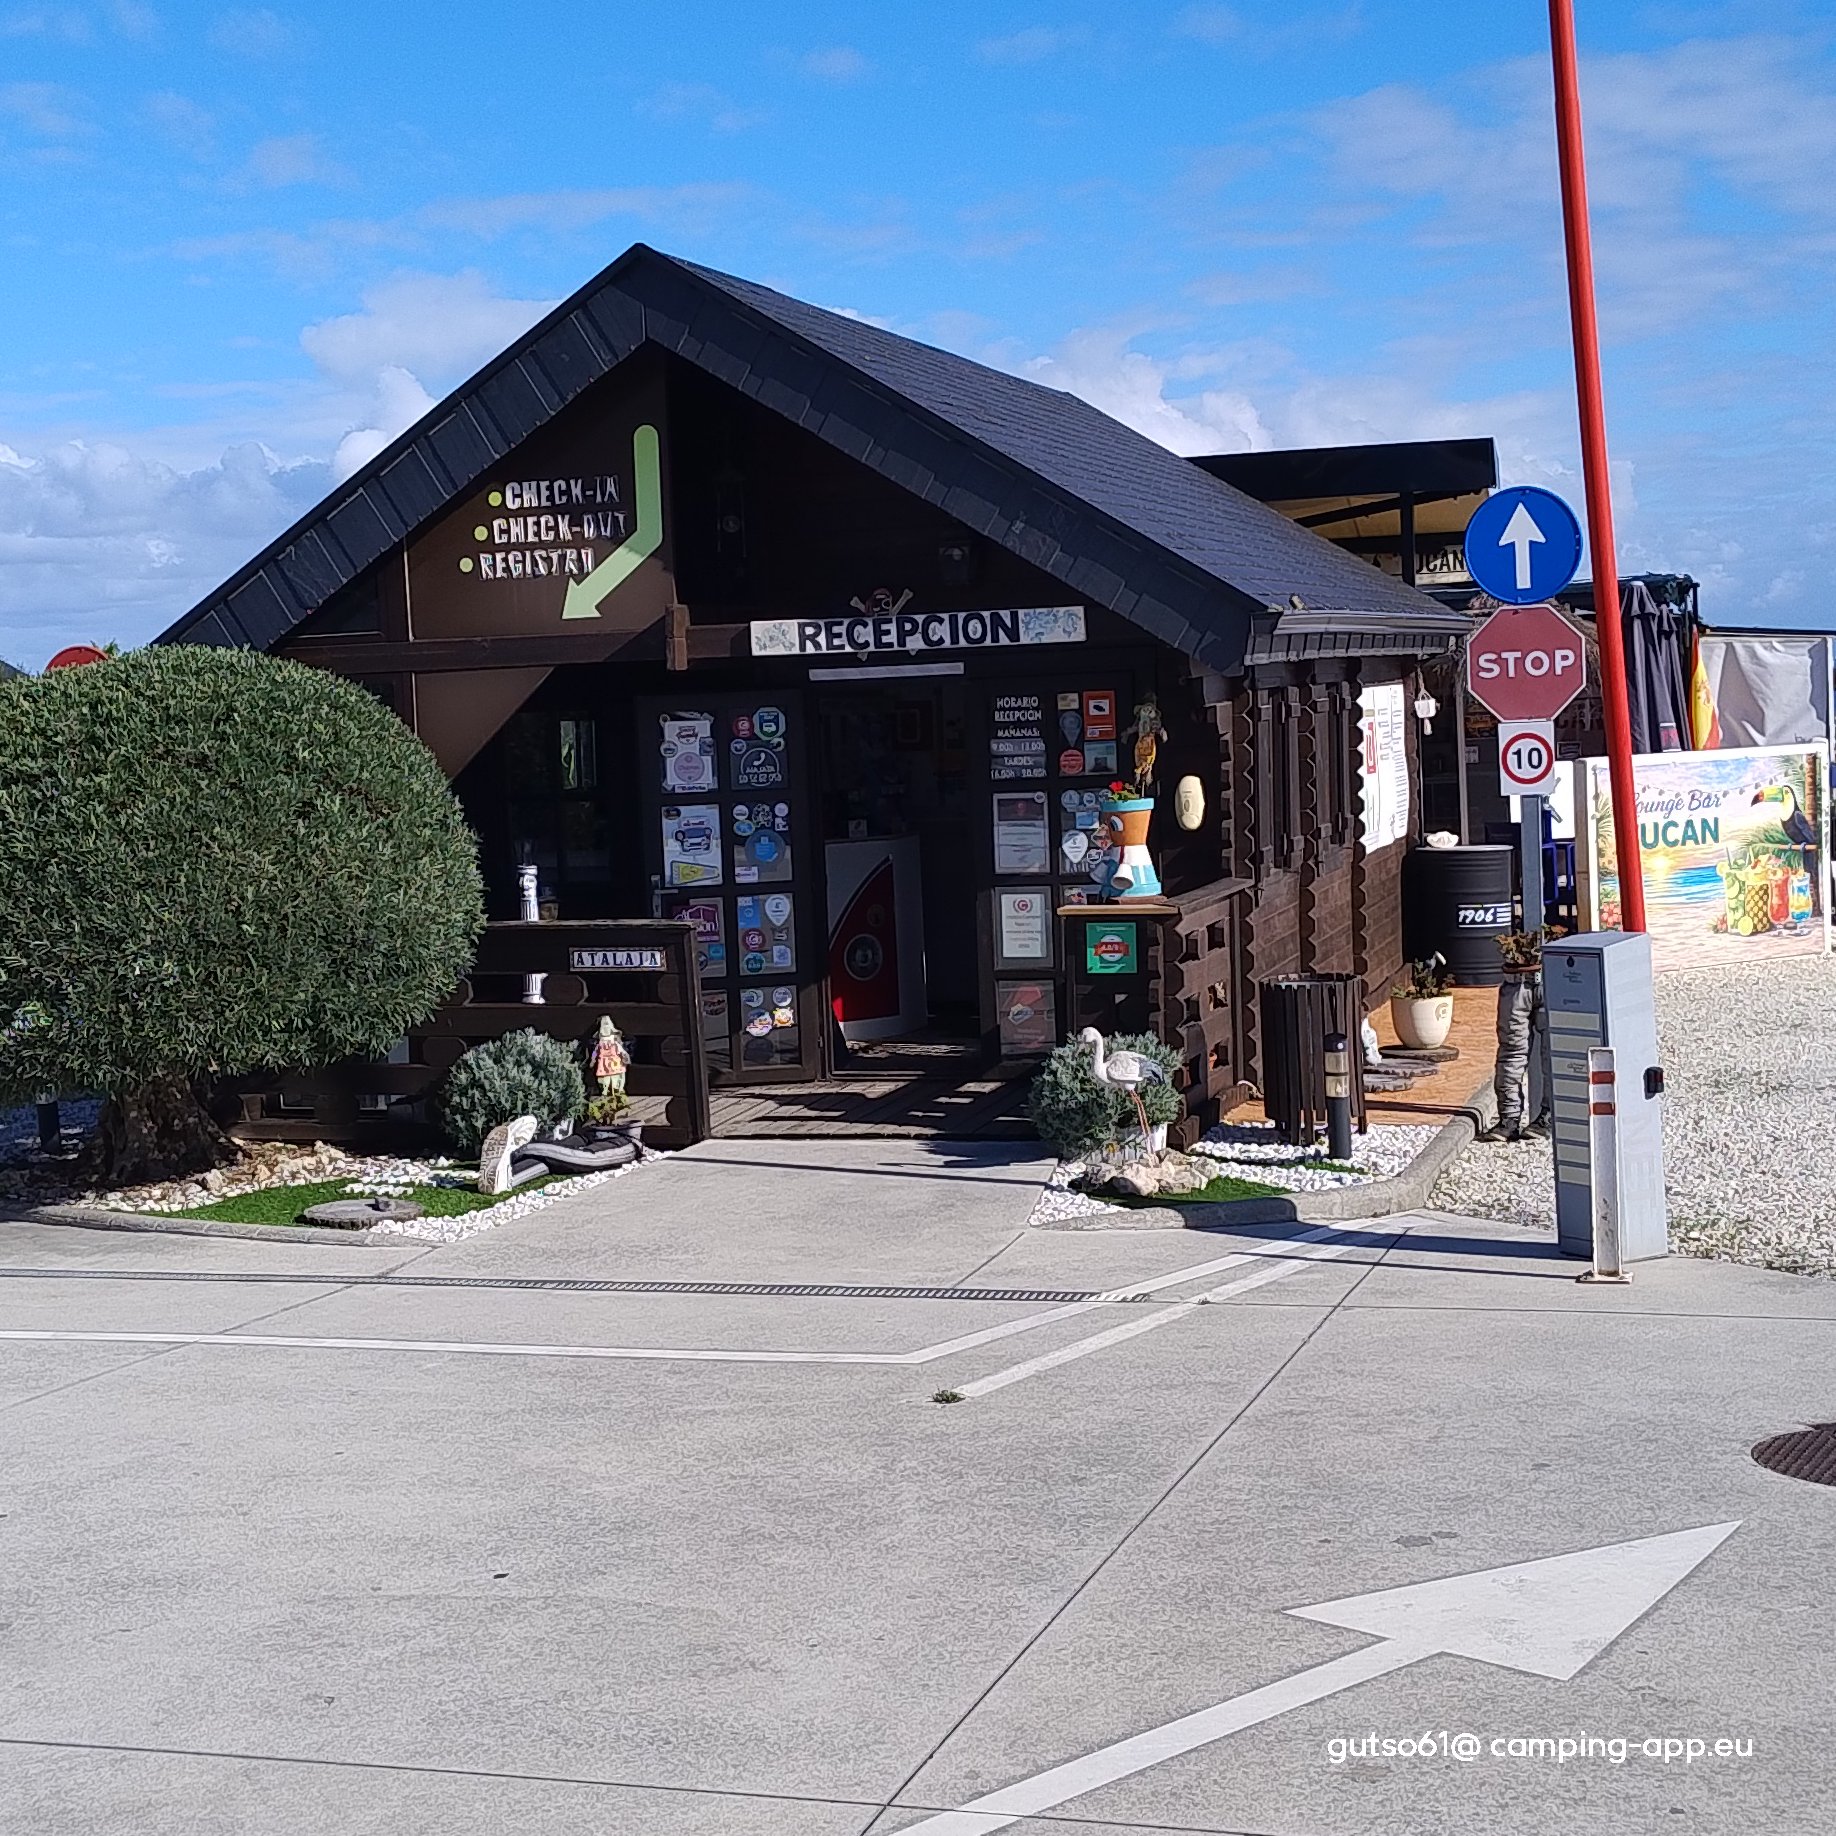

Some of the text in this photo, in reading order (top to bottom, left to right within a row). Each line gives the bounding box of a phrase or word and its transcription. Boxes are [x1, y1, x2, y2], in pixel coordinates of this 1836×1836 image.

[505, 475, 620, 510] CHECK-IN
[492, 510, 628, 544] CHECK-OUT
[799, 610, 1020, 652] RECEPCION
[1477, 649, 1576, 679] STOP
[1511, 747, 1543, 770] 10
[1635, 789, 1722, 819] ounge Bar
[1458, 908, 1495, 924] 1906
[576, 952, 660, 967] ATALAIA
